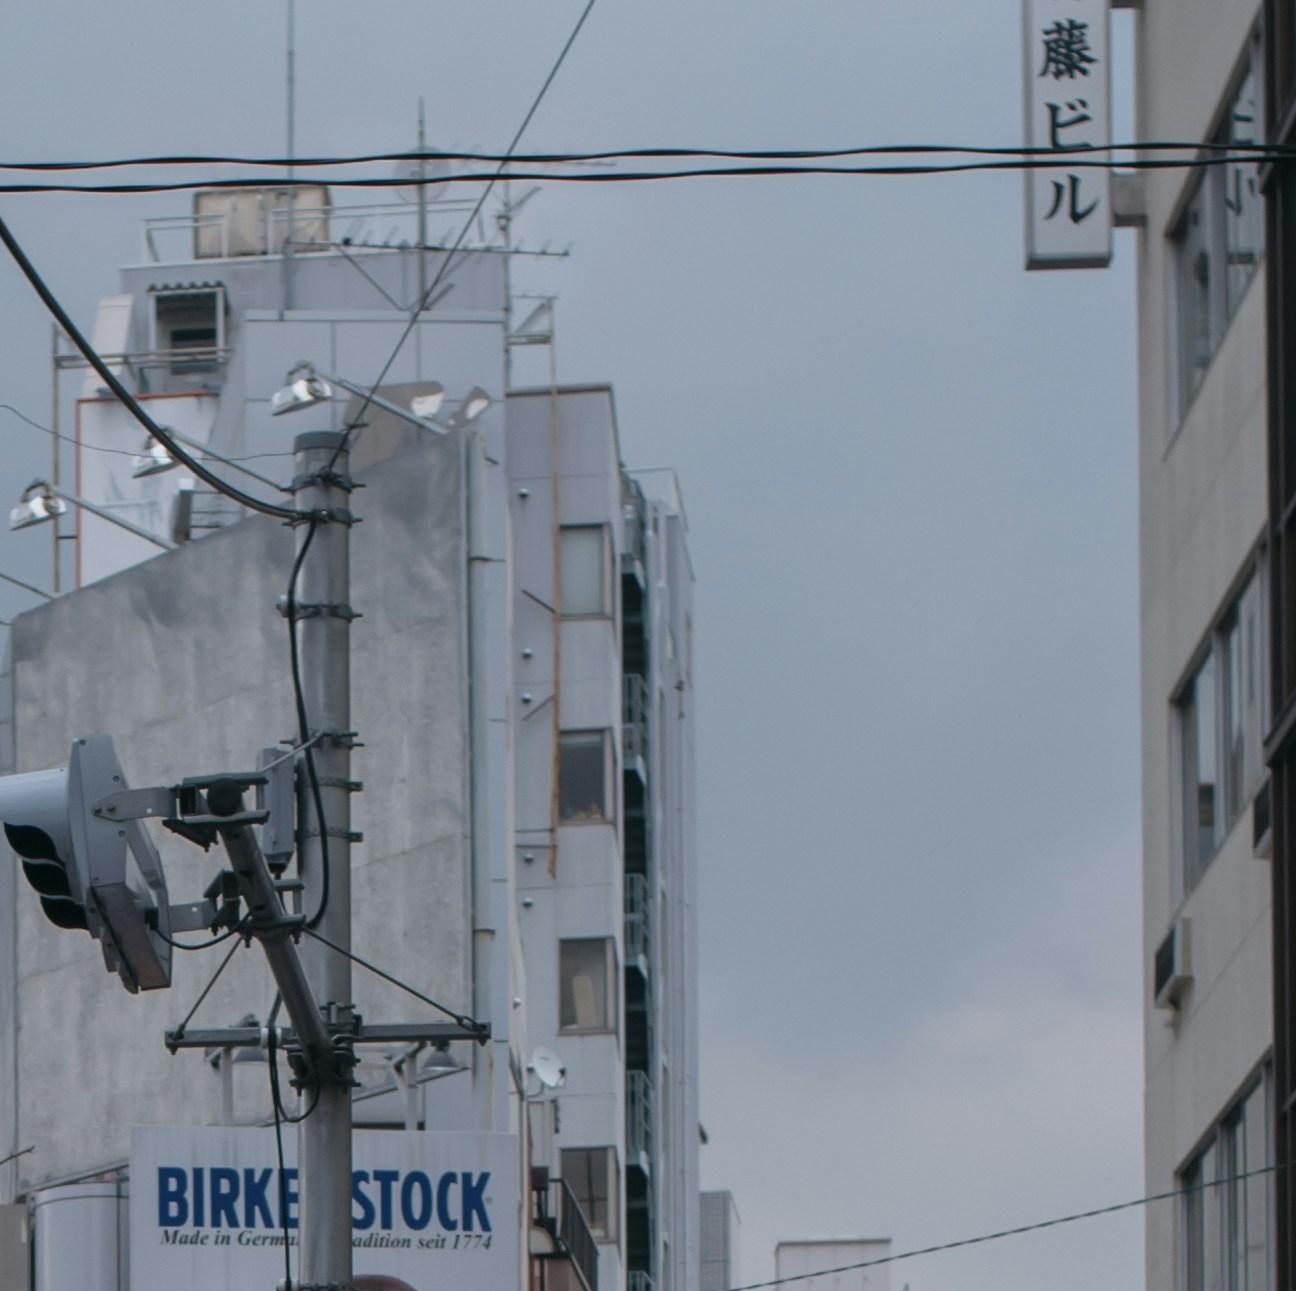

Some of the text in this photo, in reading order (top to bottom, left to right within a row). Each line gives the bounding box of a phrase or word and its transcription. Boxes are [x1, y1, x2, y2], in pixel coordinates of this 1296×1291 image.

[1038, 18, 1099, 225] 藤ビル
[157, 1166, 492, 1232] BIRKESTOCK
[160, 1229, 209, 1246] Made
[214, 1230, 232, 1246] in
[417, 1234, 446, 1249] seit
[452, 1234, 492, 1251] 1774
